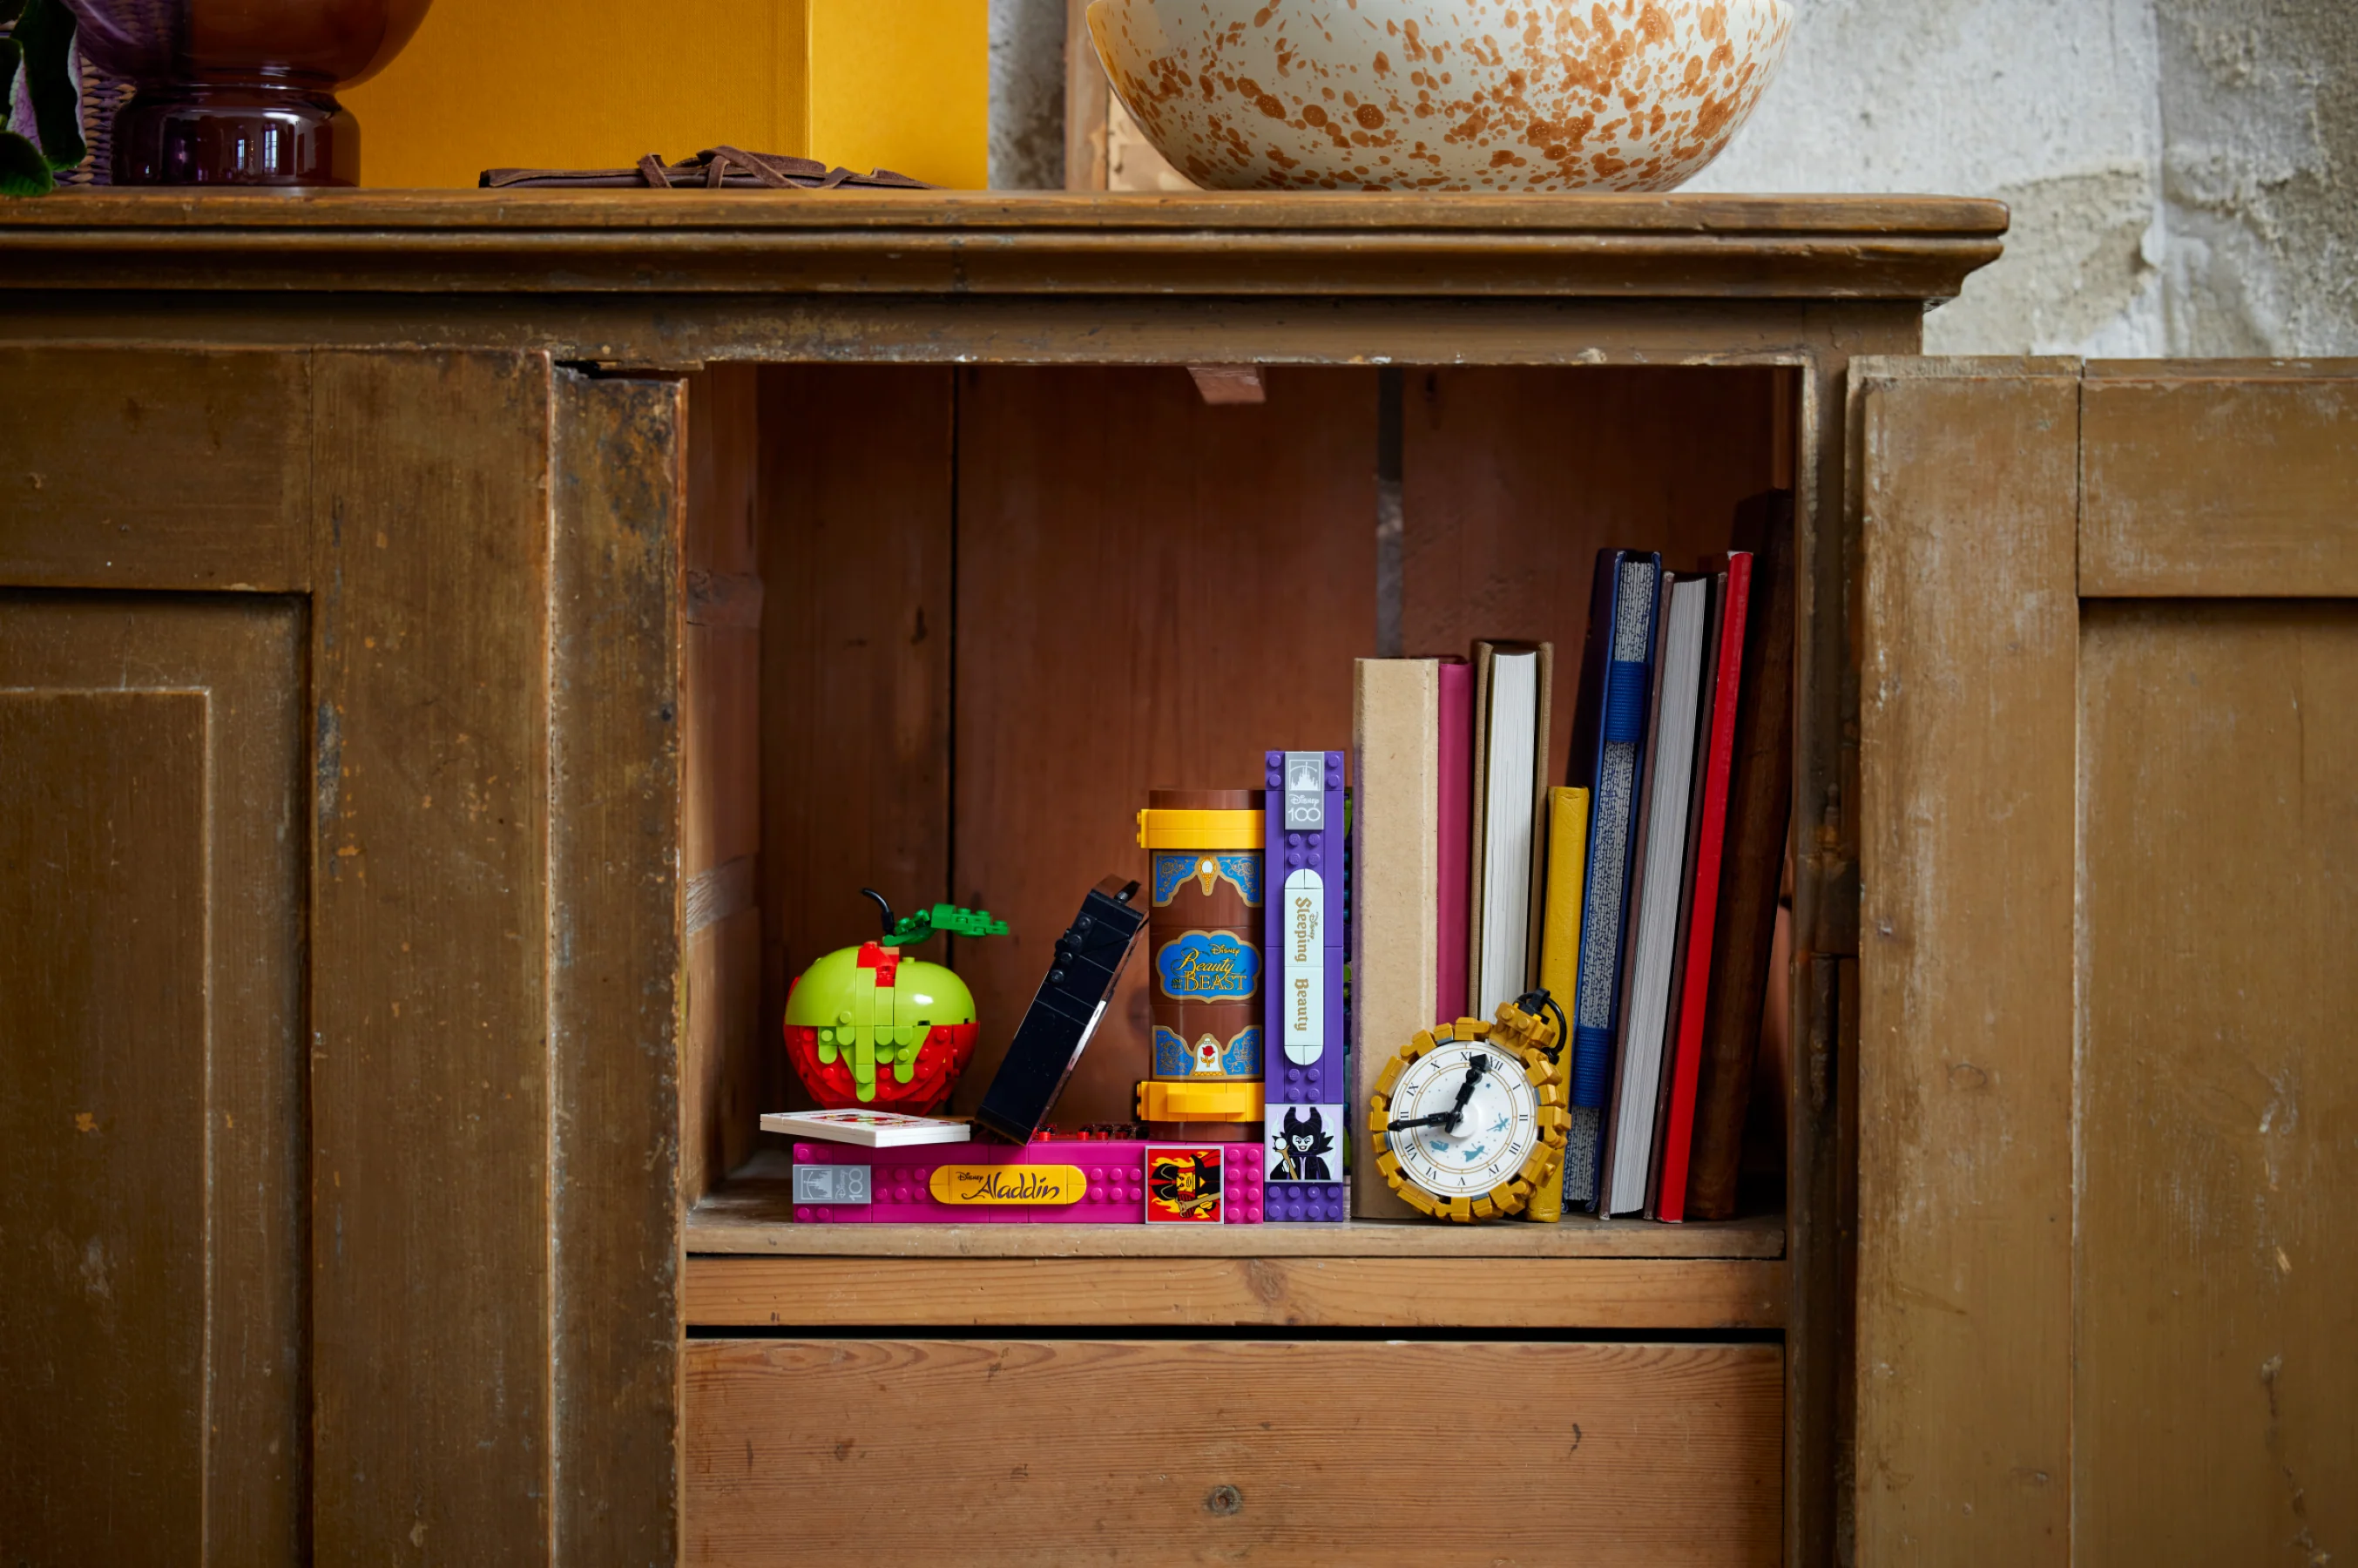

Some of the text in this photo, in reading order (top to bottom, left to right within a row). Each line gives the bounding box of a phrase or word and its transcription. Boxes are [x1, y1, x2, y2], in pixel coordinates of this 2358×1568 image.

[1289, 794, 1320, 808] Disney
[1288, 807, 1321, 822] 100
[1208, 943, 1240, 956] Disney
[1171, 947, 1247, 982] Beauty
[1294, 896, 1312, 1031] Sleeping Beauty
[1184, 972, 1247, 991] BEAST
[848, 1168, 863, 1201] 100
[956, 1172, 983, 1182] Disney
[961, 1172, 1060, 1200] Aladdin
